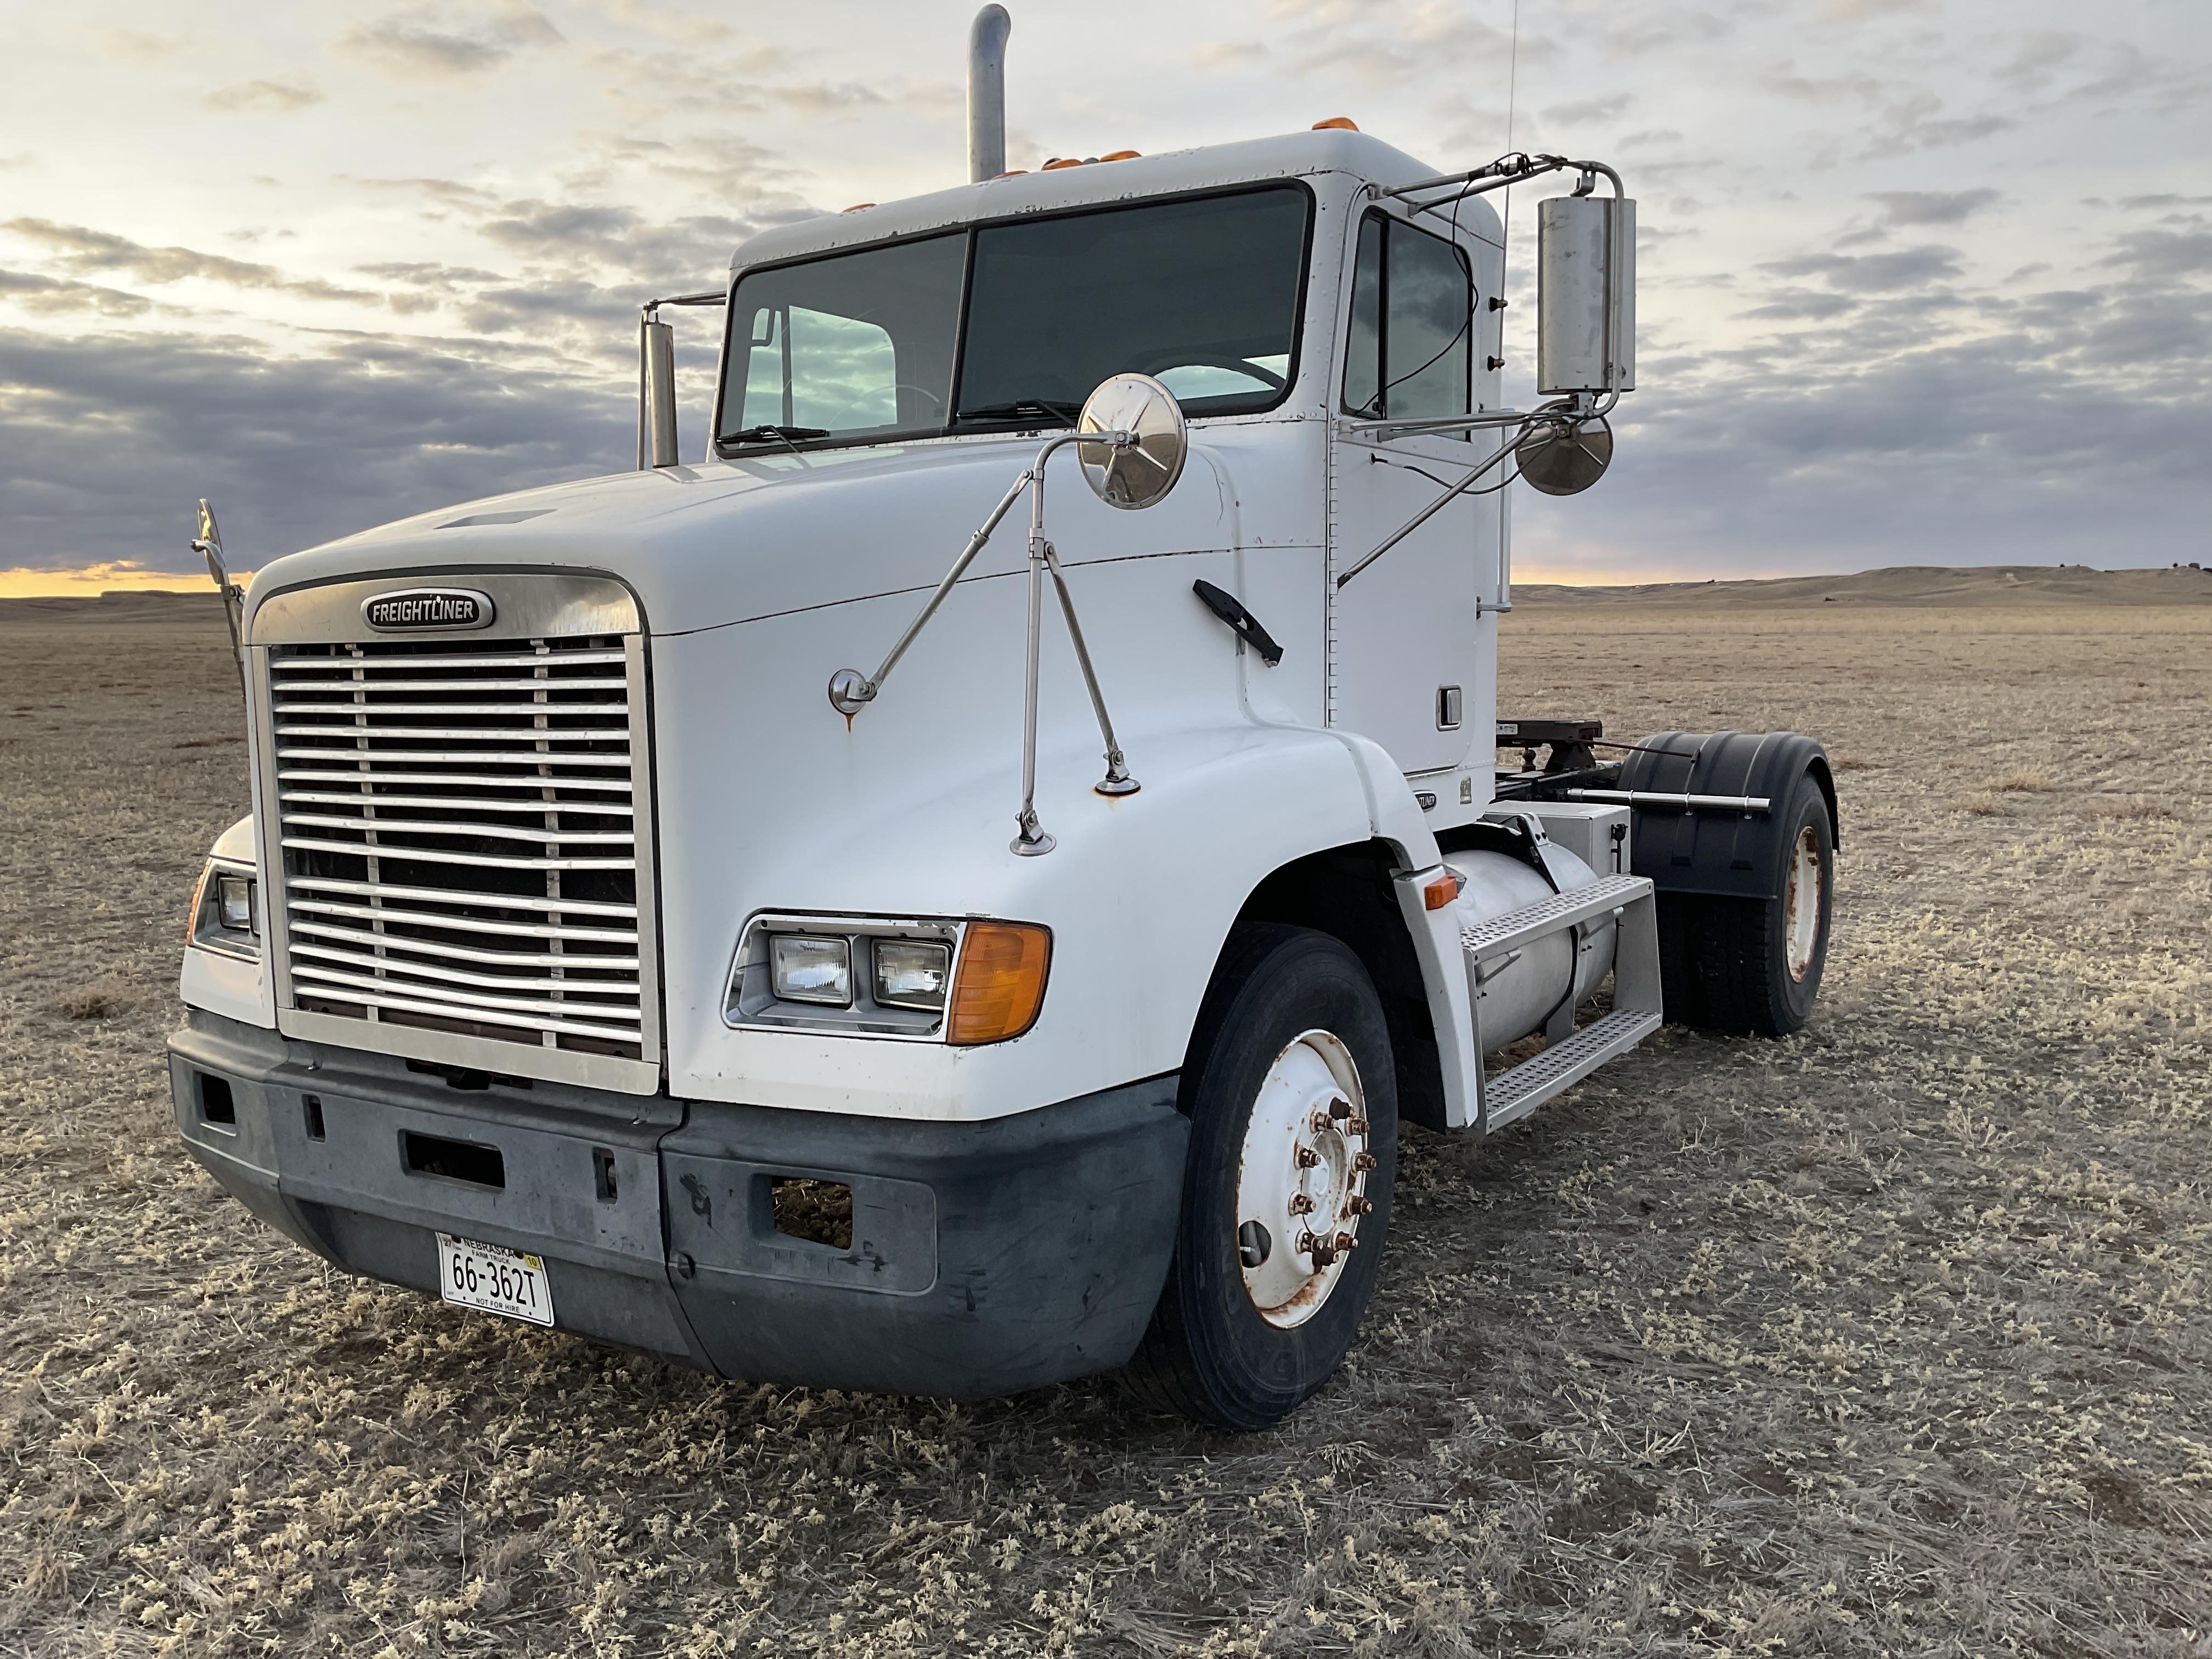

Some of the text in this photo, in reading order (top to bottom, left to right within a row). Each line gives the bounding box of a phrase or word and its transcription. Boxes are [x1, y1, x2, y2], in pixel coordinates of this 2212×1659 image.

[373, 600, 473, 622] FREIGHTLINER
[463, 1238, 515, 1259] NEBRASKA
[472, 1250, 510, 1265] FARM TRUCK
[527, 1256, 537, 1267] 10
[453, 1253, 536, 1308] 66-362T
[476, 1297, 488, 1306] NOT
